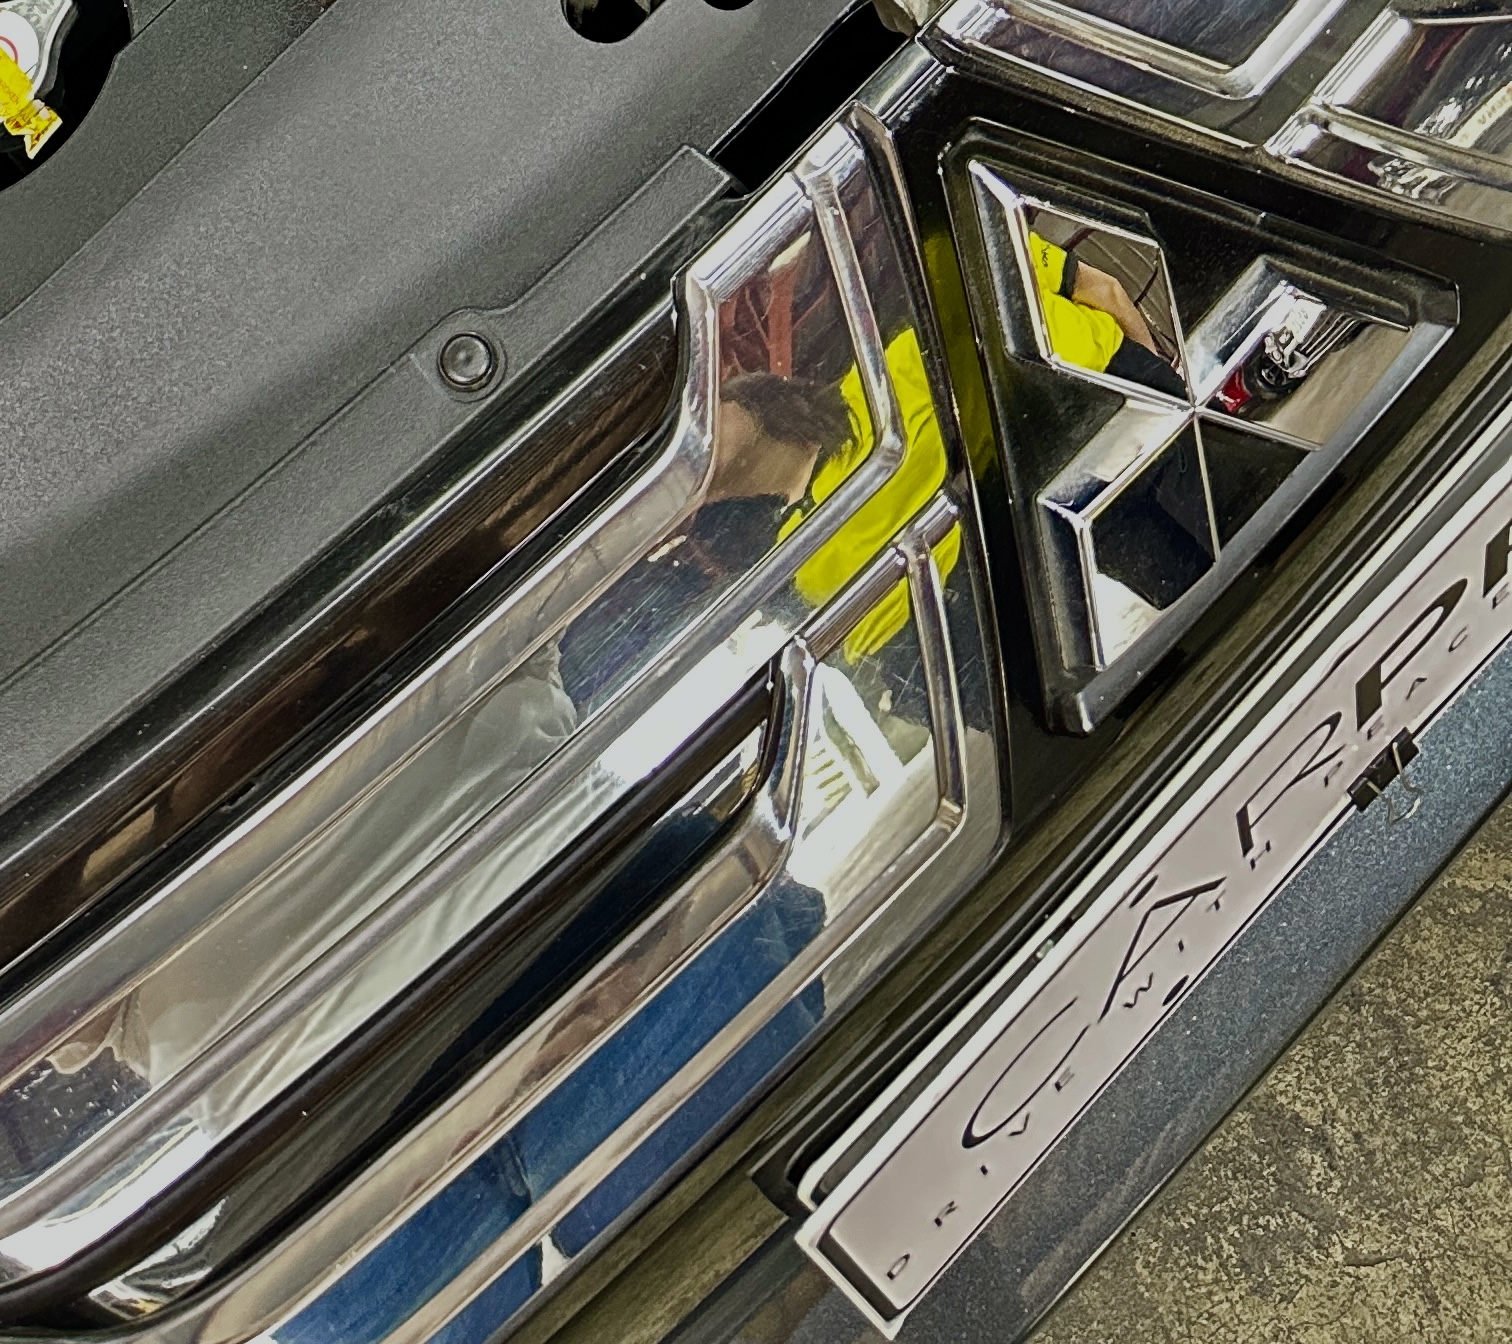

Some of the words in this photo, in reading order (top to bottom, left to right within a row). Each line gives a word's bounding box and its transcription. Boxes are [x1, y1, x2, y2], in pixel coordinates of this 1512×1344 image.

[886, 1064, 1076, 1280] DRIVE
[1121, 838, 1272, 1010] WITH
[1323, 581, 1511, 789] PEACE
